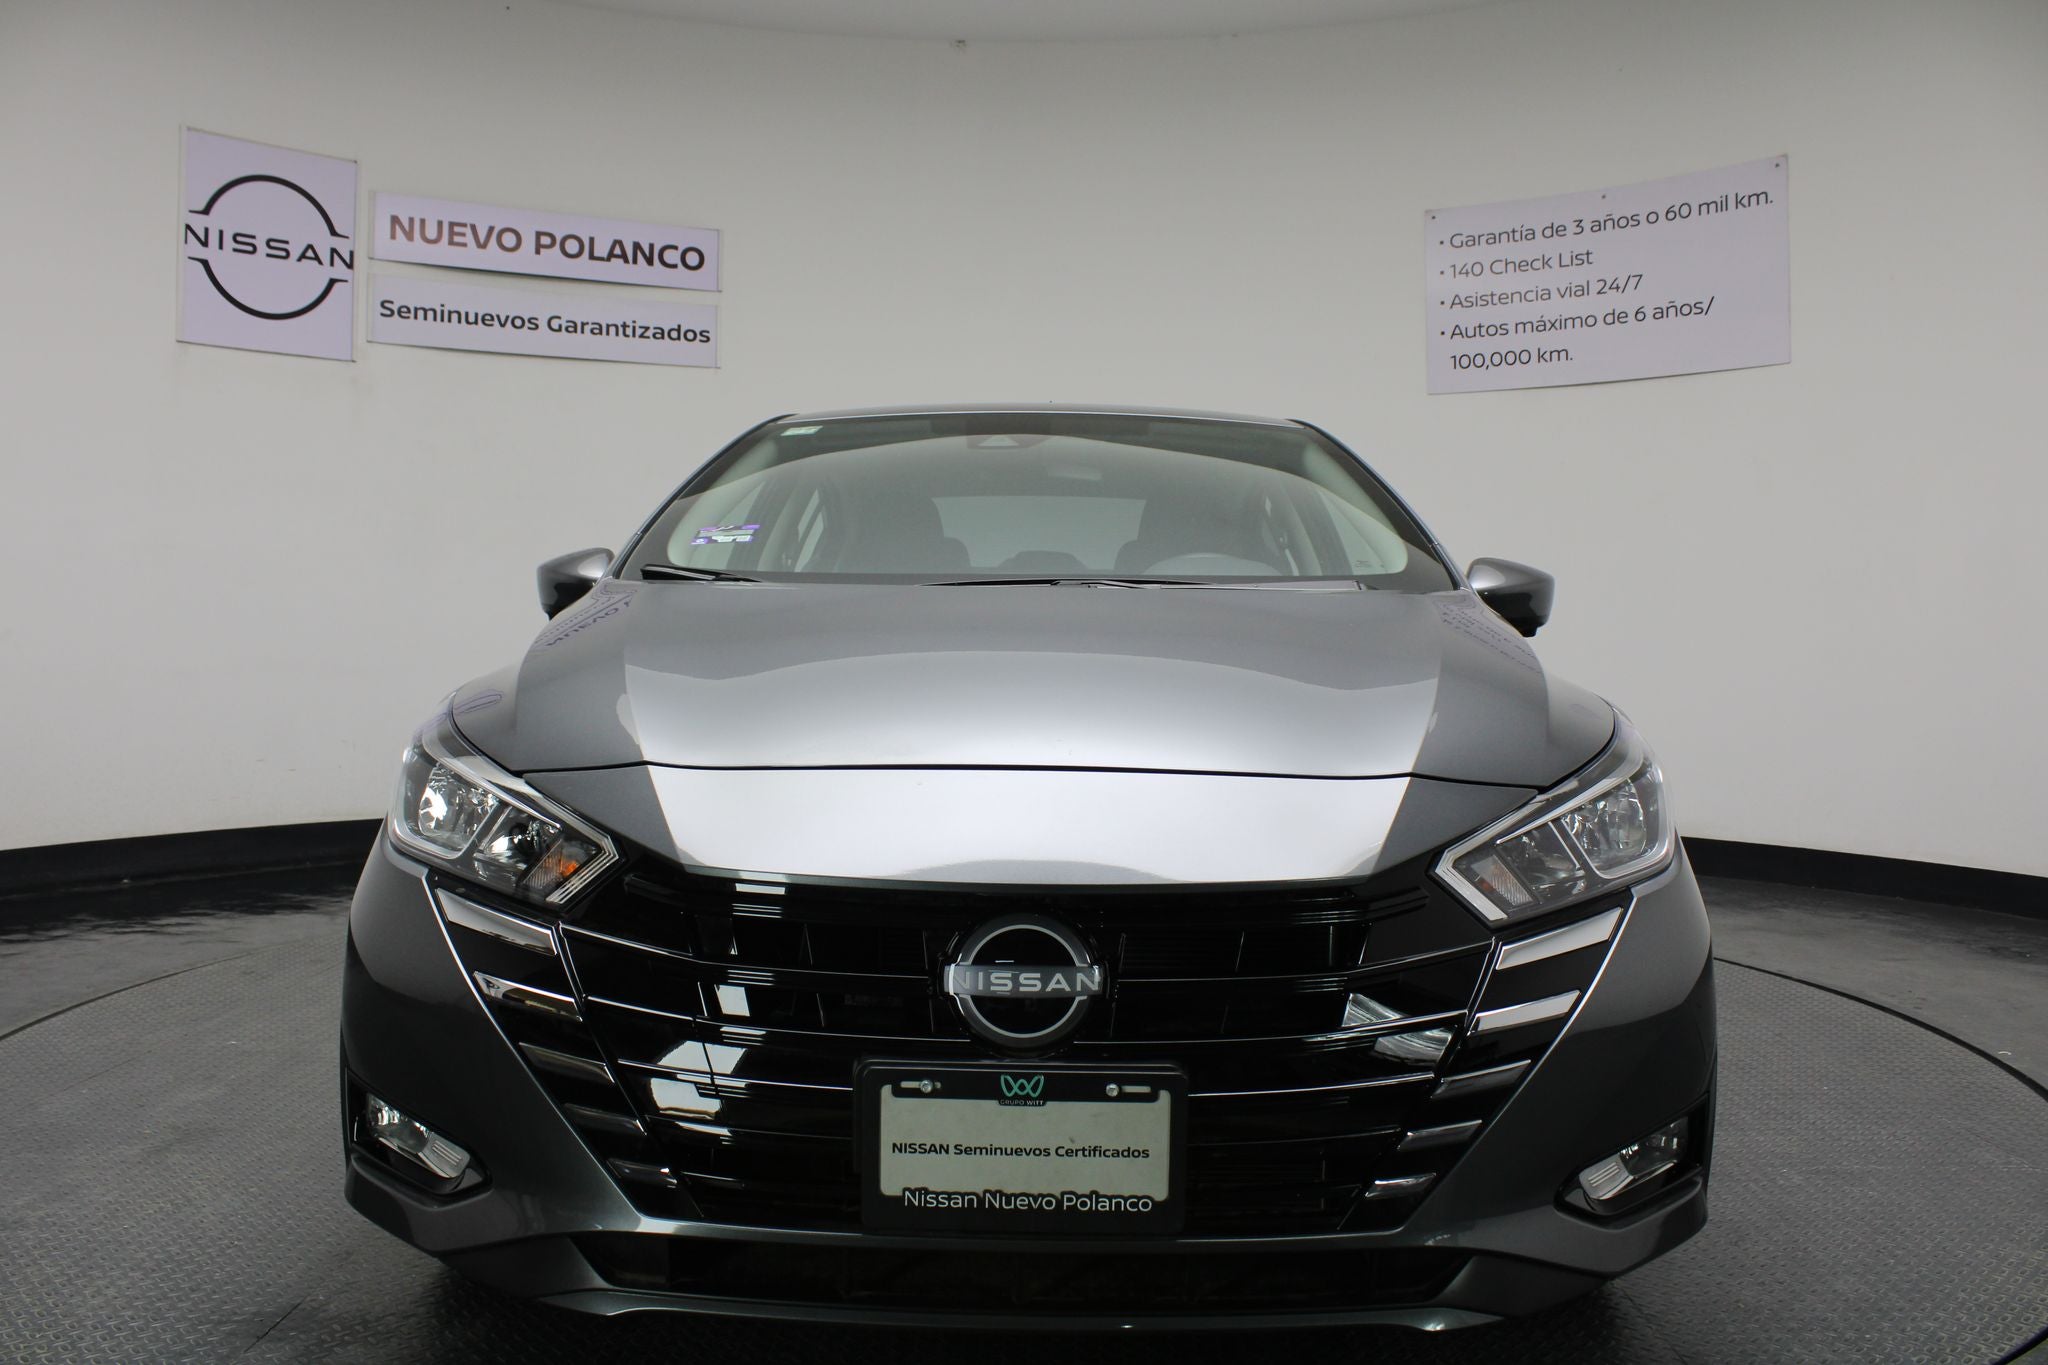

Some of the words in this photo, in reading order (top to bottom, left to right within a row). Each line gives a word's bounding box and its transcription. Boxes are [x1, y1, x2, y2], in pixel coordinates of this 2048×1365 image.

[1450, 225, 1535, 248] Garantía
[1542, 222, 1567, 238] de
[1572, 219, 1585, 235] 3
[1590, 213, 1641, 232] años
[1646, 211, 1659, 224] o
[1665, 203, 1691, 221] 60
[1698, 194, 1729, 216] mil
[1736, 190, 1774, 210] km.
[185, 222, 354, 271] NISSAN
[390, 215, 522, 252] NUEVO
[535, 231, 705, 271] POLANCO
[1450, 262, 1483, 278] 140
[1490, 254, 1552, 274] Check
[1559, 250, 1593, 267] List
[1450, 286, 1551, 309] Asistencia
[1557, 280, 1589, 298] vial
[1597, 274, 1643, 295] 24/7
[380, 300, 539, 330] Seminuevos
[547, 316, 710, 343] Garantizados
[1451, 323, 1509, 339] Autos
[1515, 313, 1597, 334] máximo
[1603, 309, 1628, 325] de
[1635, 306, 1646, 321] 6
[1653, 296, 1714, 320] años/
[1451, 350, 1531, 370] 100,000
[1537, 346, 1573, 363] km.
[952, 971, 1099, 992] NISSAN
[892, 1143, 949, 1154] NISSAN
[954, 1144, 1051, 1157] Seminuevos
[1055, 1146, 1149, 1158] Certificados
[904, 1191, 977, 1208] Nissan
[985, 1193, 1055, 1210] Nuevo
[1063, 1194, 1152, 1212] Polanco
